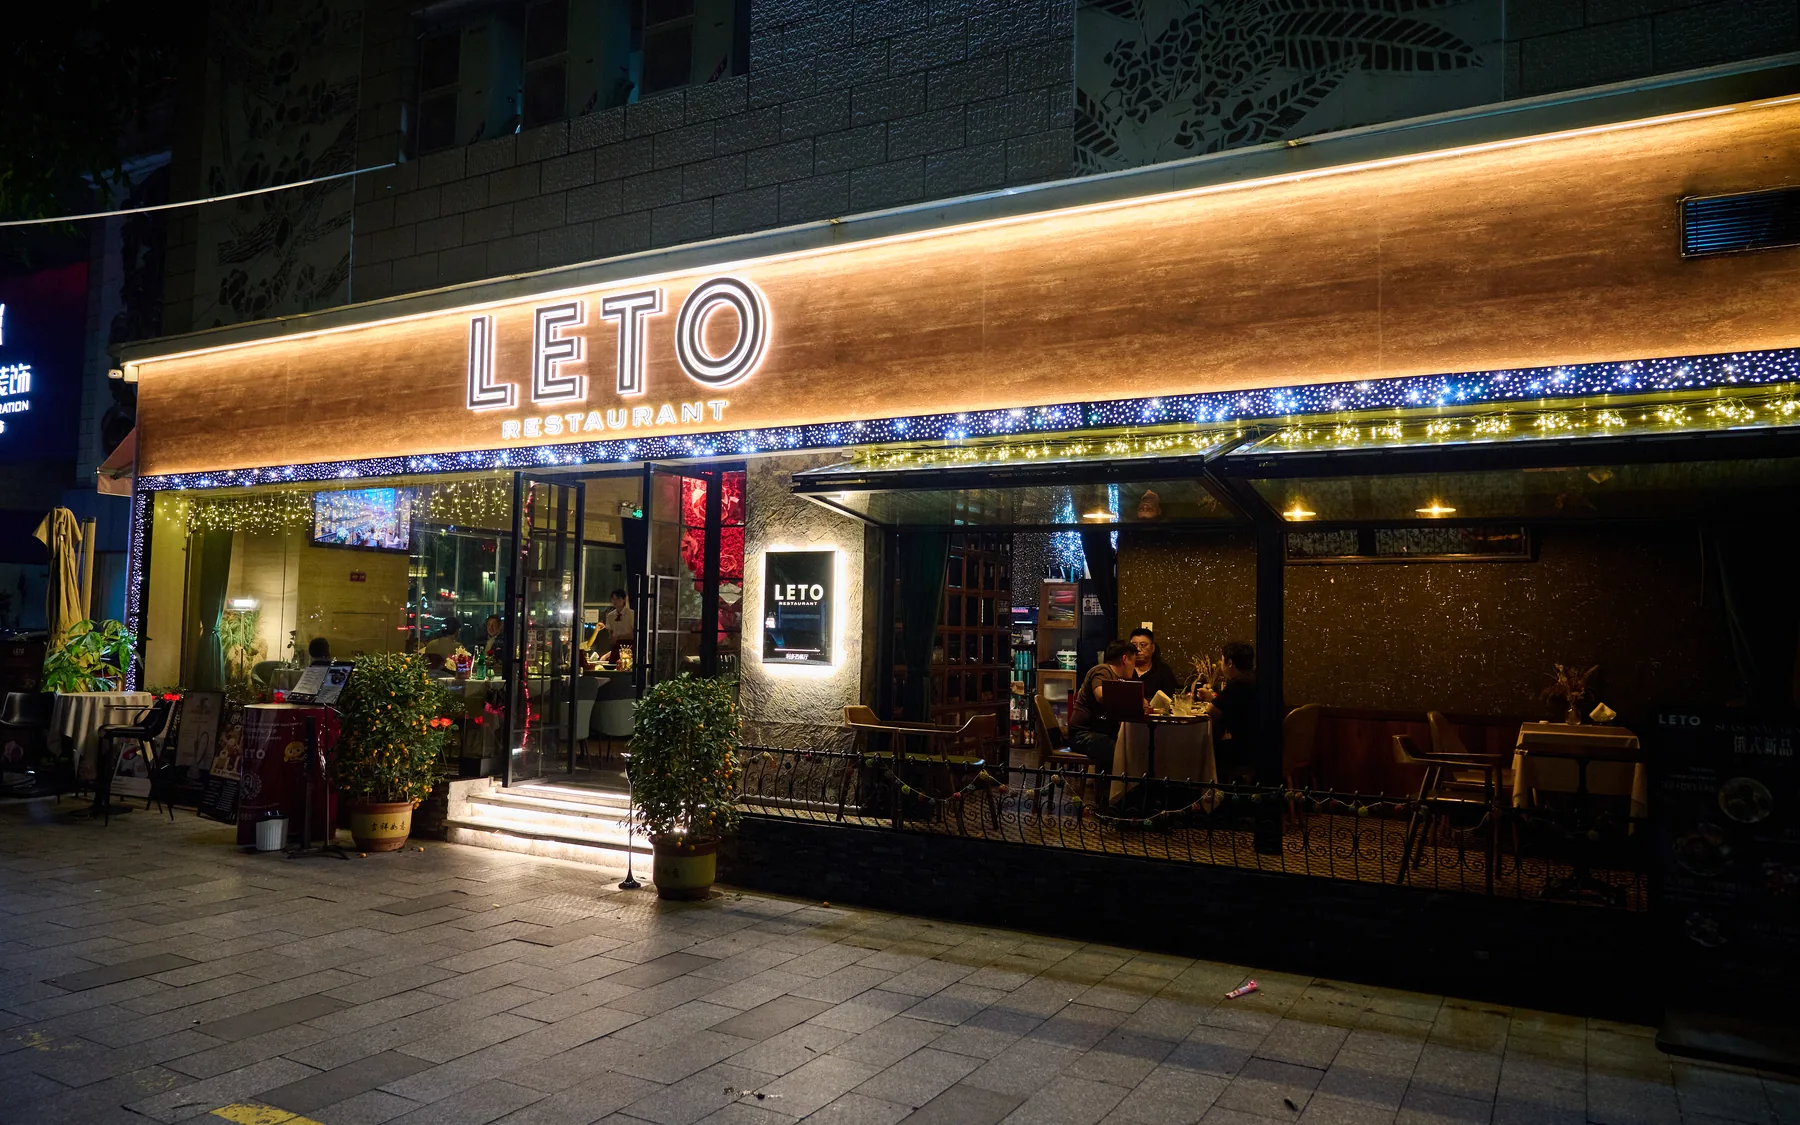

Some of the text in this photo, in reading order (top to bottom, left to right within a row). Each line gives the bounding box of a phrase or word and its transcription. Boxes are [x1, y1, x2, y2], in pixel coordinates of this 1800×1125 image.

[466, 277, 772, 411] LETO
[501, 398, 728, 440] RESTAURANT
[774, 584, 824, 601] LETO
[1657, 713, 1702, 727] LETO
